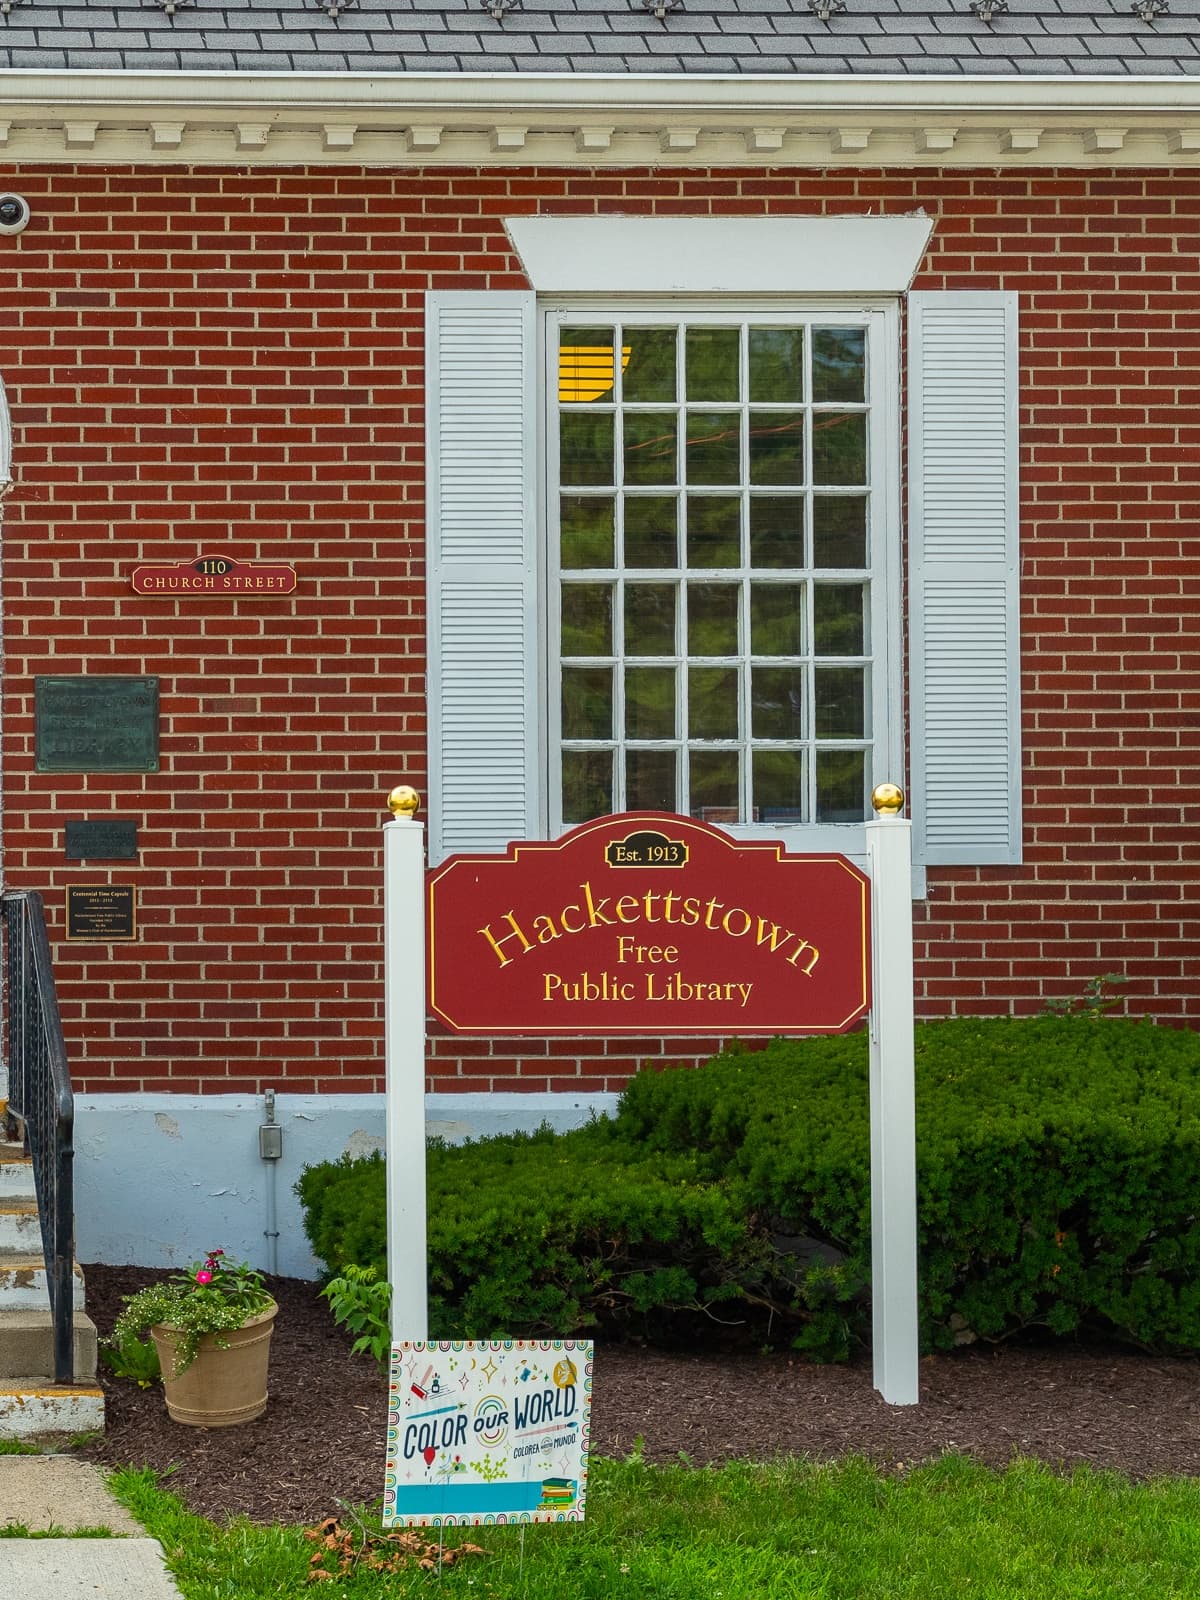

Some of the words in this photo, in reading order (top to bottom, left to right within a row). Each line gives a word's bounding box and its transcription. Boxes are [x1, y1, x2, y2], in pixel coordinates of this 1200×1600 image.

[202, 561, 226, 574] 110
[143, 577, 215, 588] CHURCH
[223, 577, 287, 588] STREET
[615, 846, 642, 862] Est.
[646, 846, 679, 862] 1913
[477, 881, 822, 978] Hackettstown
[616, 935, 679, 964] Free
[543, 972, 635, 1002] Public
[646, 971, 753, 1008] Library
[403, 1414, 468, 1460] COLOR
[473, 1411, 510, 1433] OUR
[514, 1384, 576, 1430] WORLD
[553, 1433, 576, 1449] MUNDO
